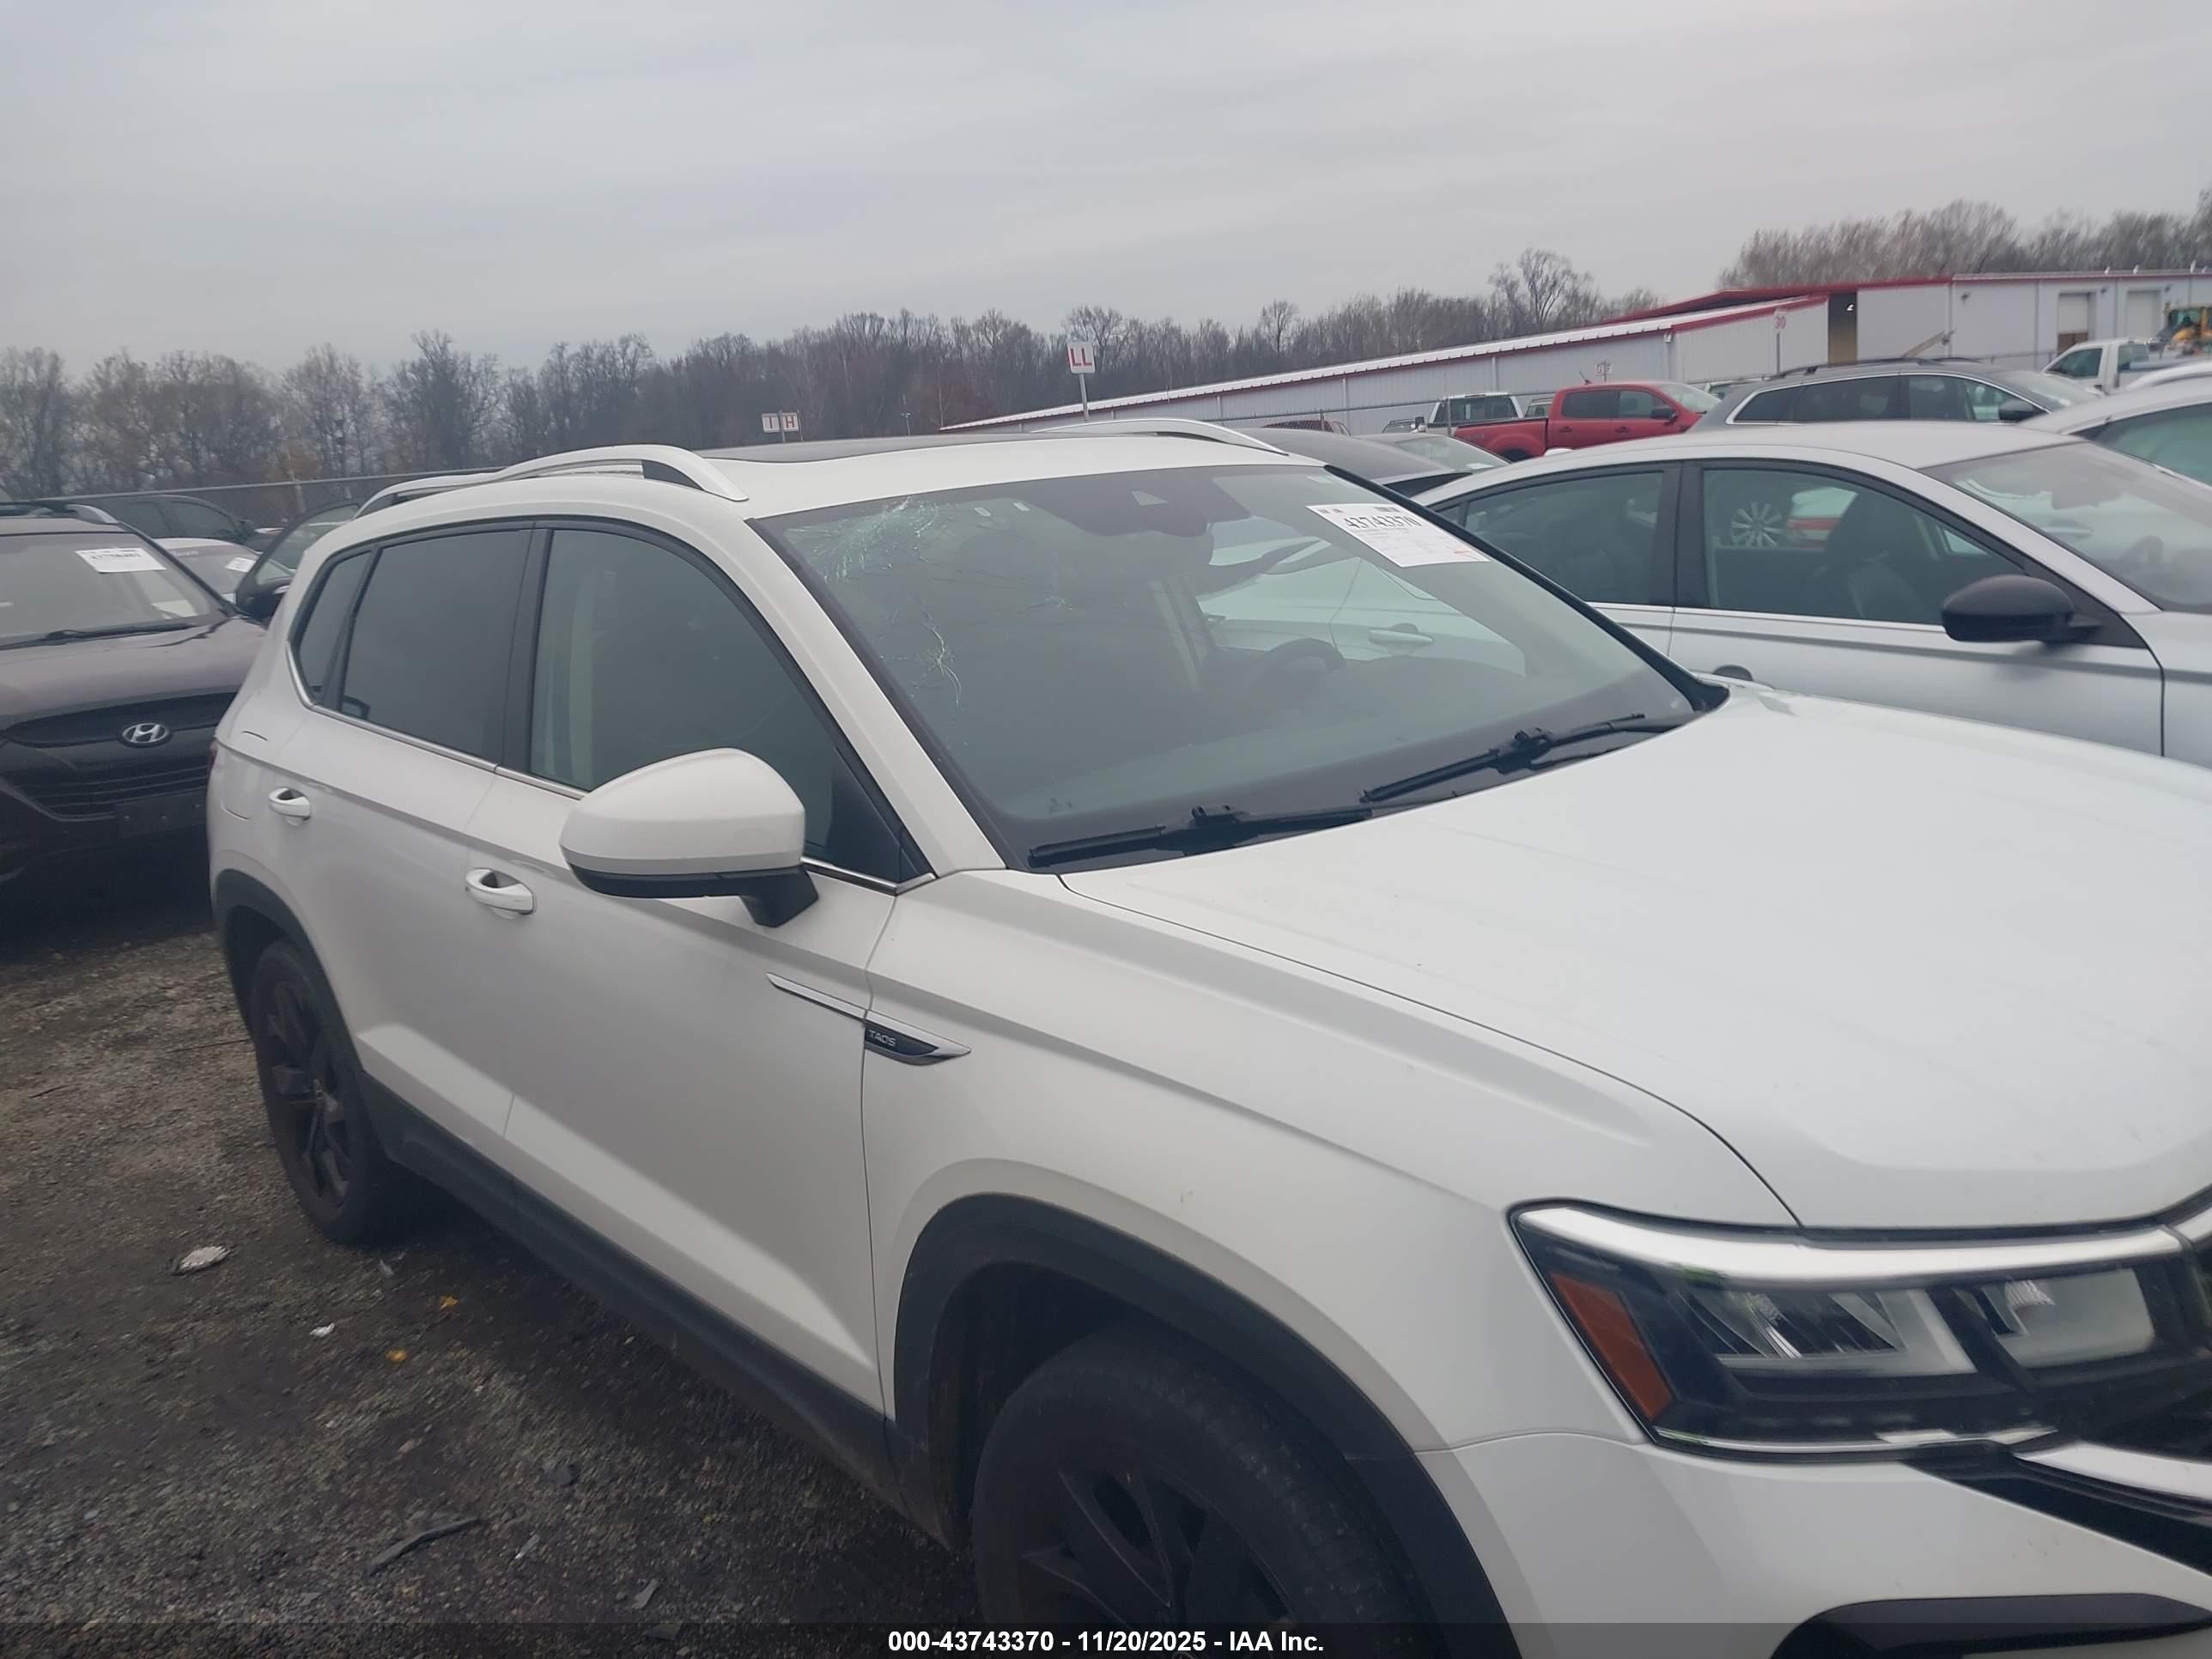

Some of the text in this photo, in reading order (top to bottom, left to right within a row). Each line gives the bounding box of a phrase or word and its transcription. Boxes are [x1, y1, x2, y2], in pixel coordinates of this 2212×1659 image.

[1070, 348, 1093, 367] LL
[785, 415, 795, 428] H
[1344, 515, 1423, 528] 43743370
[867, 1029, 897, 1048] TAOS
